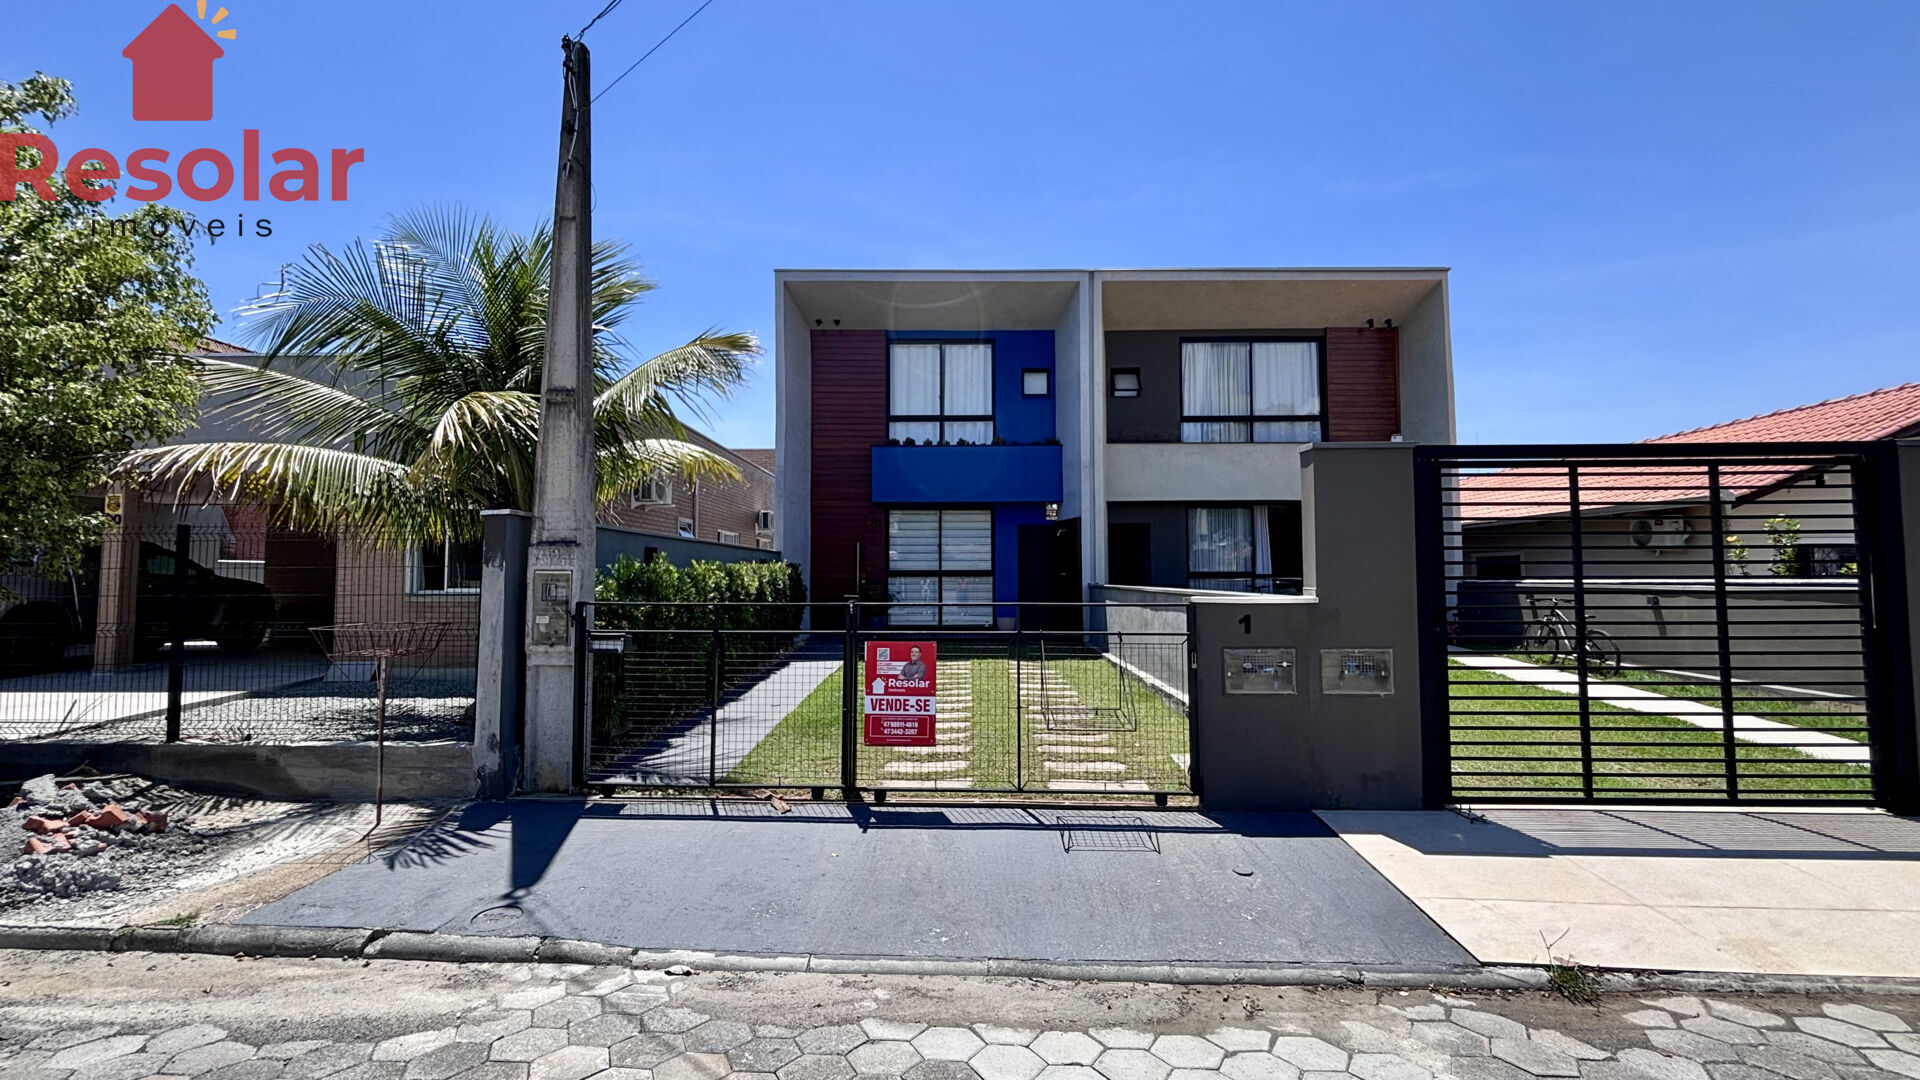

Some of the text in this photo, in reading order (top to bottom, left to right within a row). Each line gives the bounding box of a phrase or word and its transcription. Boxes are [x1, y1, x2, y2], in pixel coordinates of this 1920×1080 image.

[1238, 614, 1252, 634] 1
[888, 679, 930, 687] Resolar
[870, 698, 930, 712] VENDE-SE
